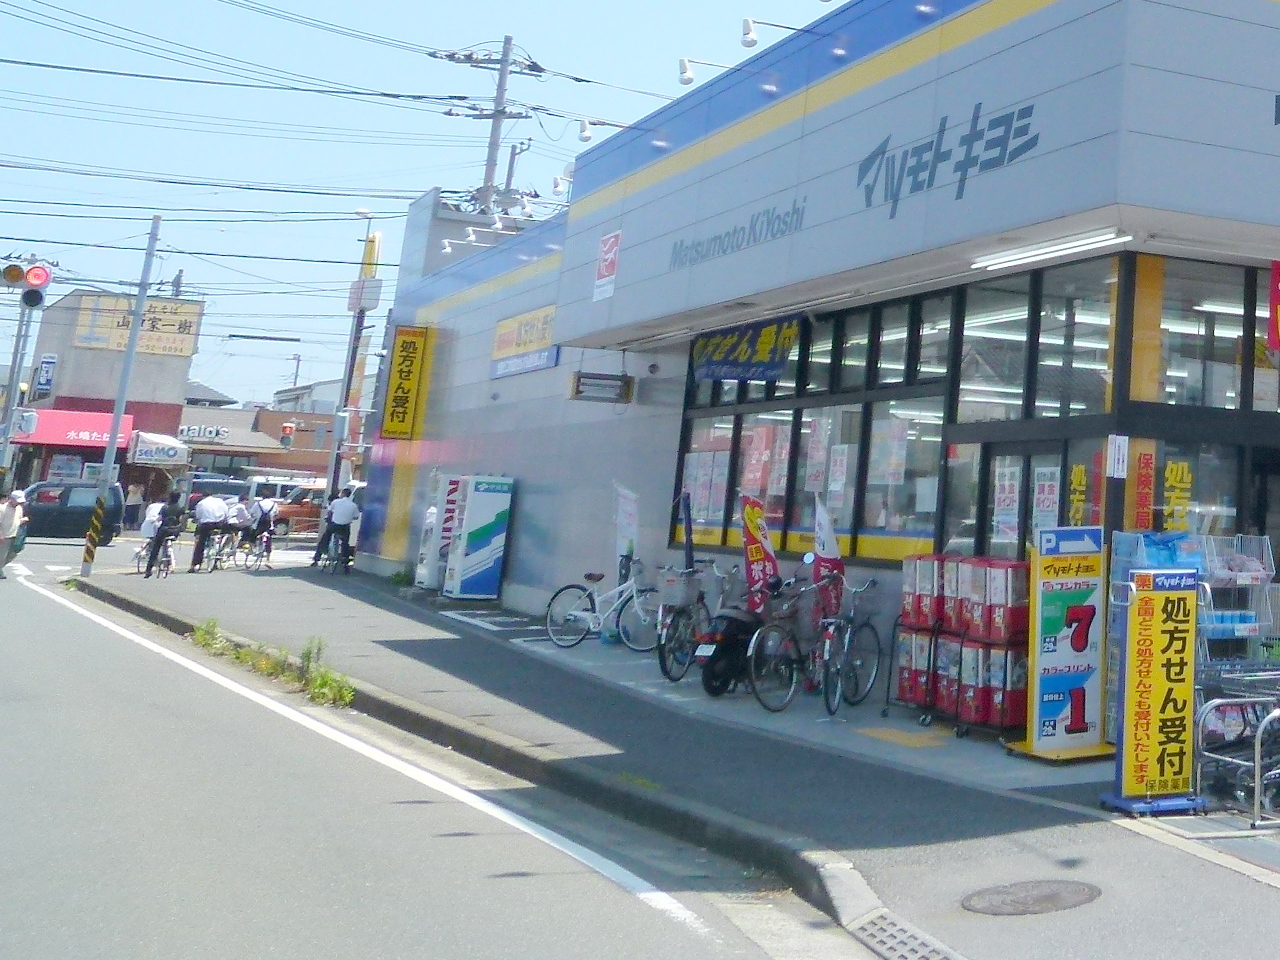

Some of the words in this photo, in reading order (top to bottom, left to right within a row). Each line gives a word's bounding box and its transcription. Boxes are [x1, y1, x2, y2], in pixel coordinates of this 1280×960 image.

[857, 102, 1040, 219] マツモトキヨシ
[669, 224, 746, 270] Matsumoto
[747, 195, 807, 246] KiYoshi
[390, 340, 418, 423] 処方せん受付
[1068, 464, 1087, 527] 処方
[1042, 533, 1057, 555] P
[1043, 563, 1096, 577] マツモトキヨシ
[1065, 604, 1096, 653] 7
[1065, 687, 1089, 735] 1
[1156, 596, 1191, 778] 処方せん受付
